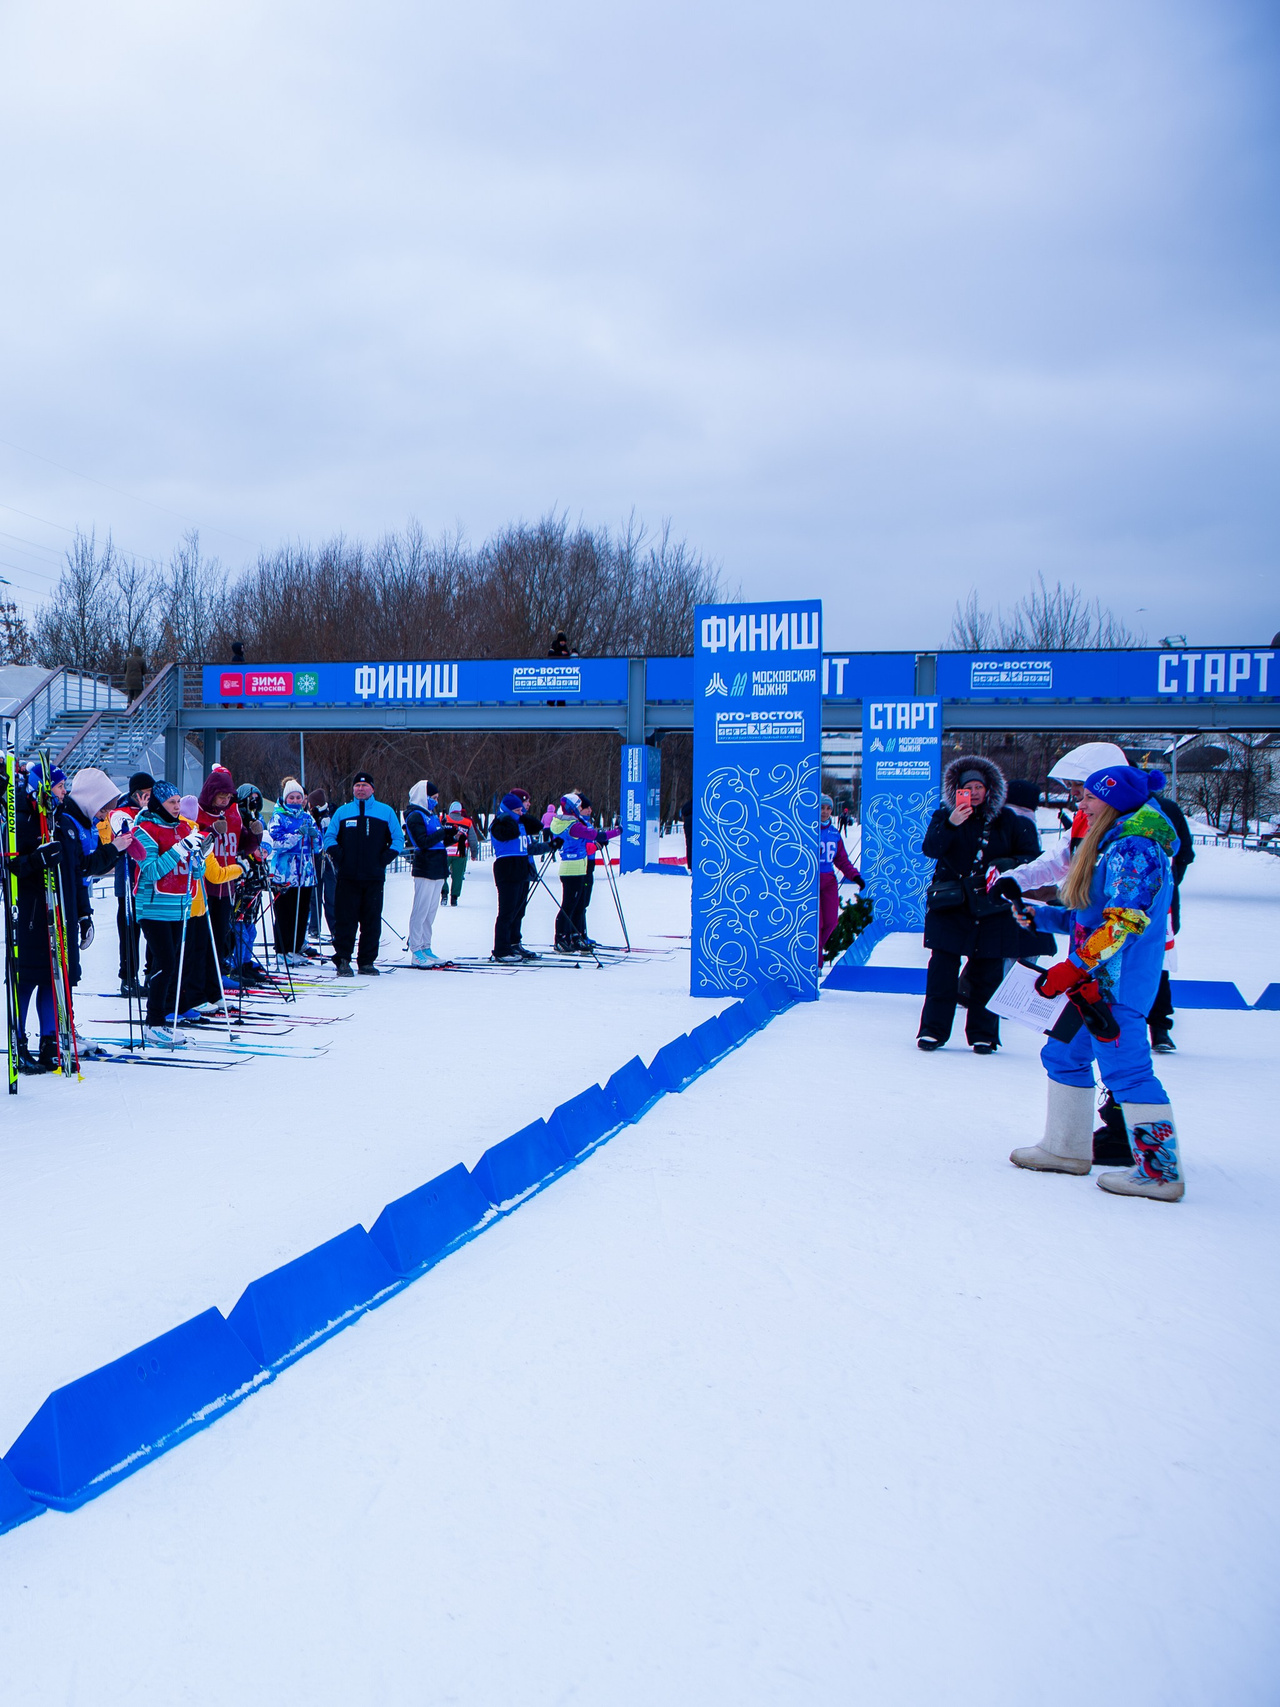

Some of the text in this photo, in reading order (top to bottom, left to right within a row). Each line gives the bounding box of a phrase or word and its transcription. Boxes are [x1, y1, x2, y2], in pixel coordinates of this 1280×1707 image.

[702, 612, 819, 653] ФИНИШ
[513, 666, 580, 675] ЮГО-ВОСТОК
[971, 661, 1052, 669] ЮГО-ВОСТОК
[752, 670, 816, 683] МОСКОВСКАЯ
[1158, 653, 1275, 693] СТАРТ
[251, 677, 286, 686] ЗИМА
[354, 664, 459, 699] ФИНИШ
[752, 683, 788, 696] ЛЫЖНЯ
[715, 710, 804, 721] ЮГО-ВОСТОК
[870, 703, 938, 729] СТАРТ
[898, 737, 938, 745] МОСКОВСКАЯ
[1093, 782, 1111, 797] SKI
